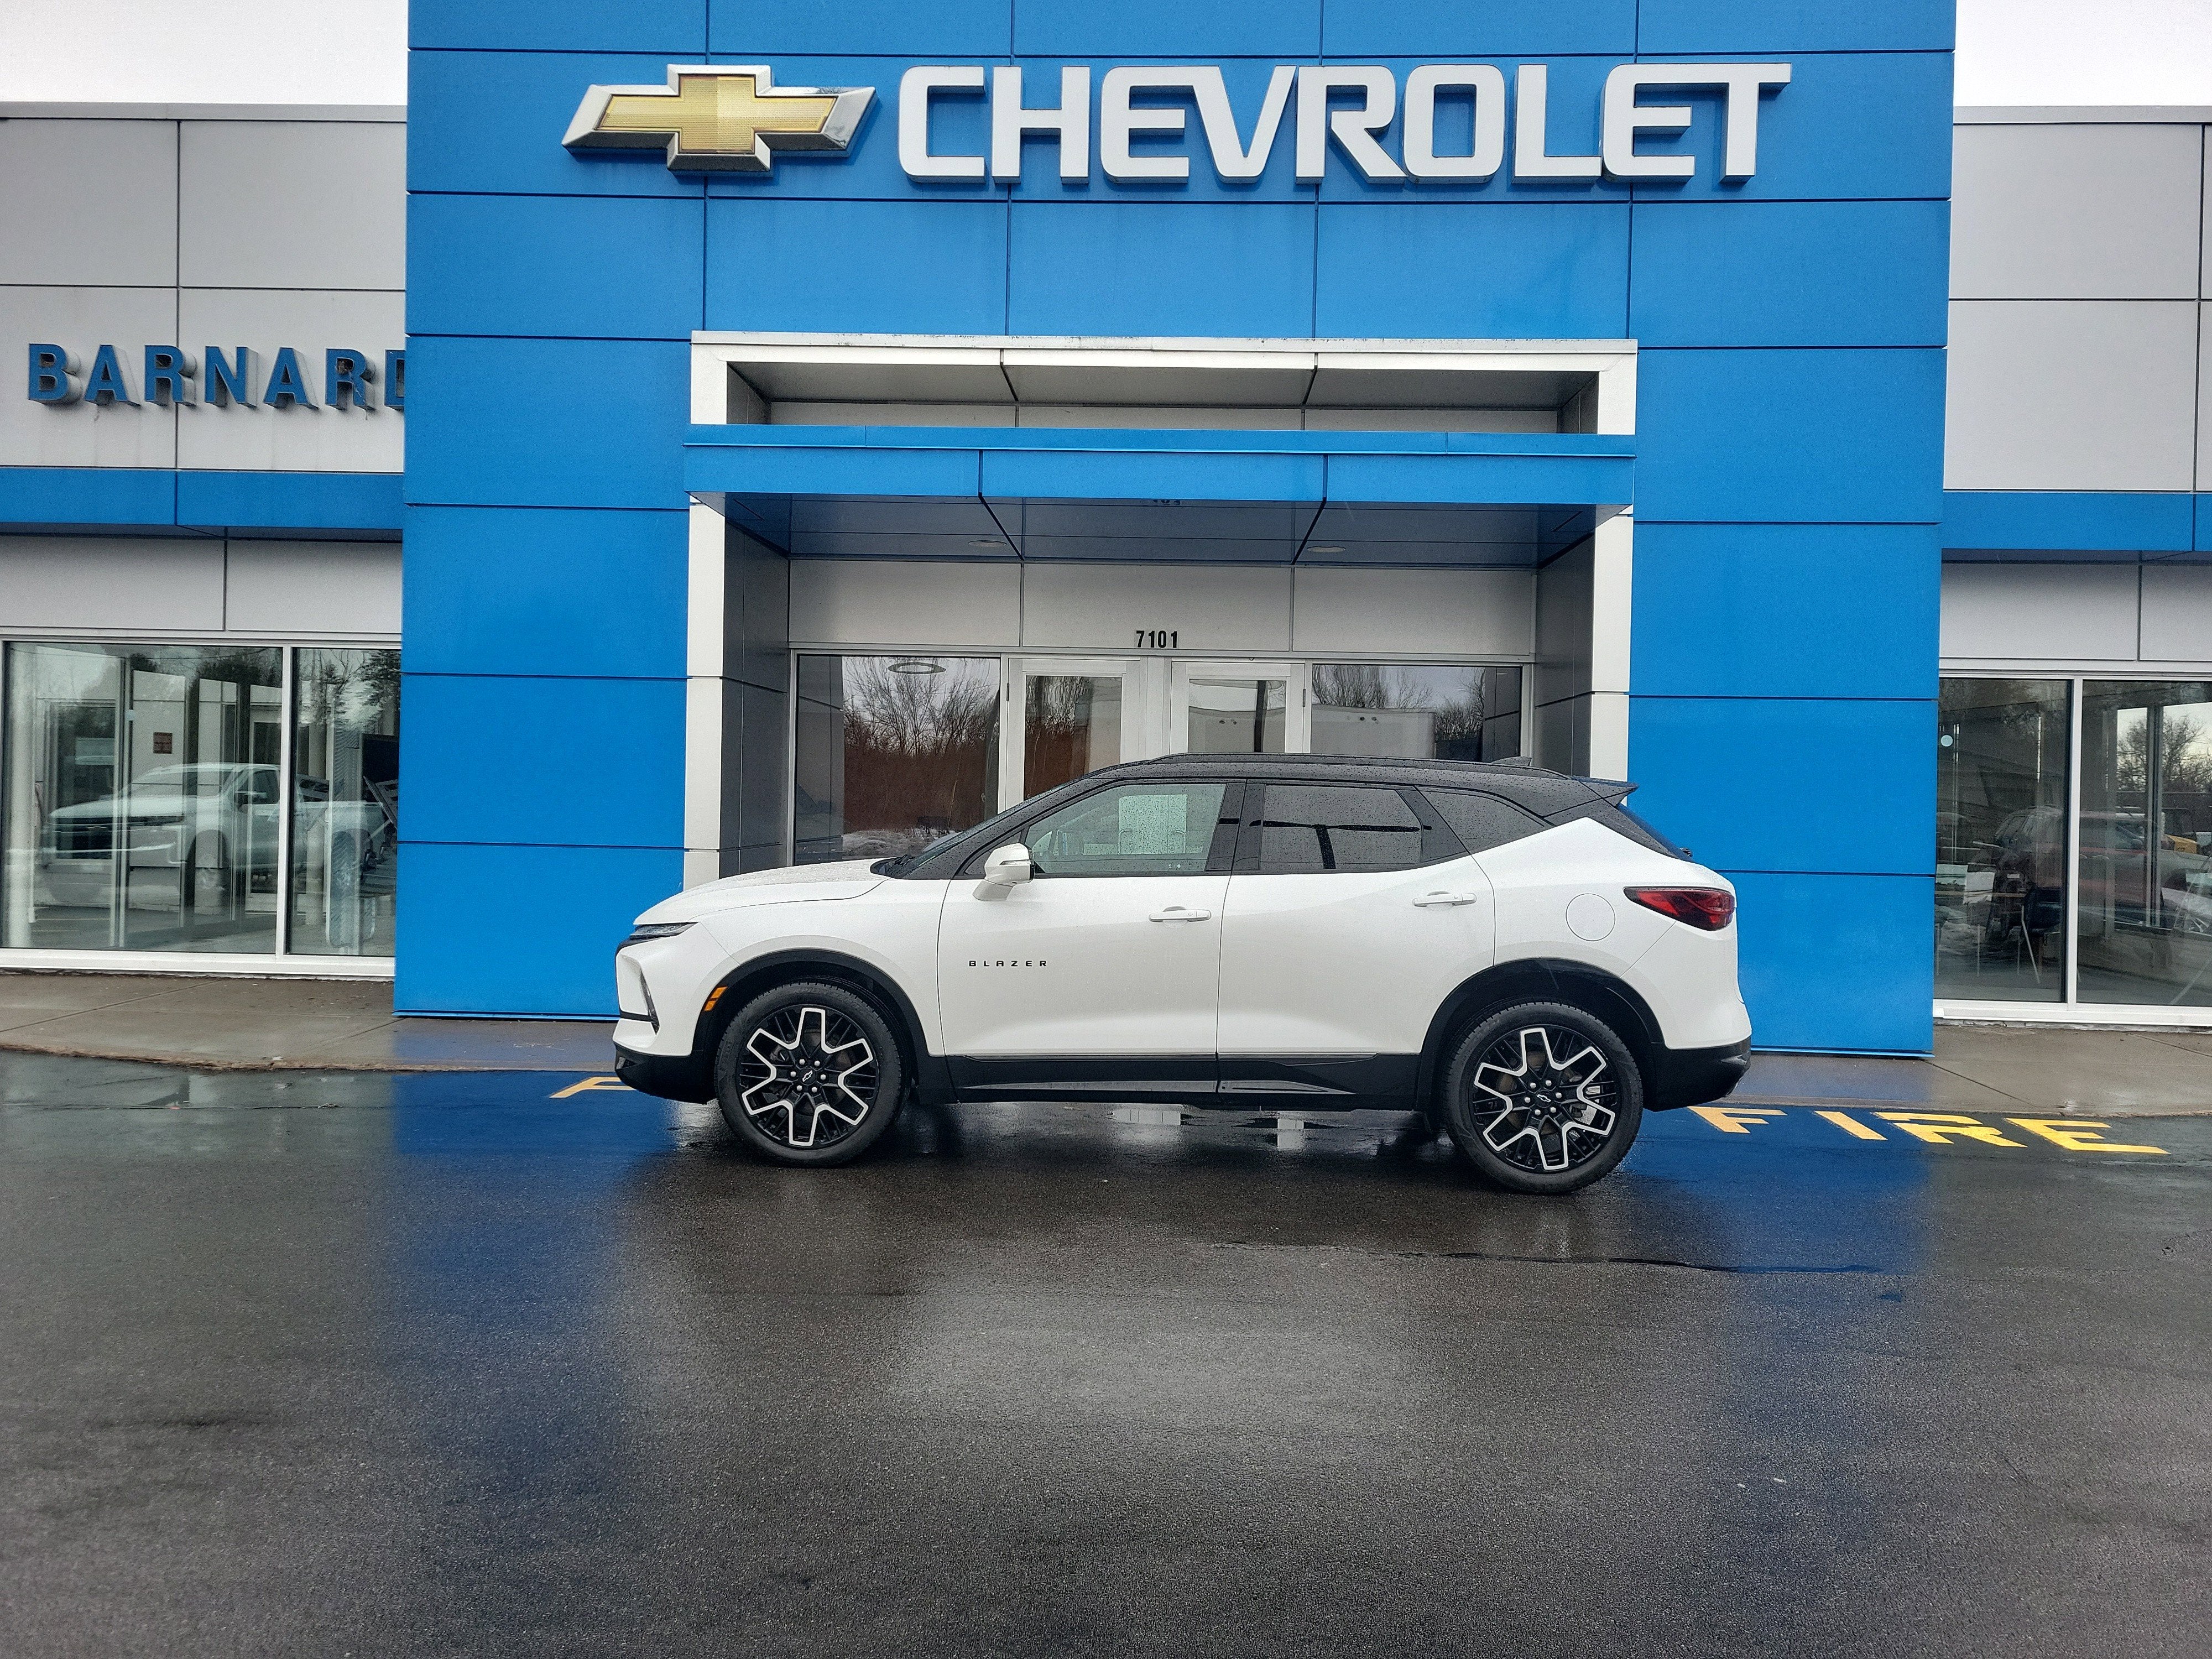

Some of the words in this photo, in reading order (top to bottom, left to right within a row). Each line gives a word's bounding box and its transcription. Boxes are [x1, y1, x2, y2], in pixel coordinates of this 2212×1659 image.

[899, 62, 1792, 180] CHEVROLET
[1136, 630, 1177, 649] 7101
[1687, 1105, 2172, 1155] FIRE
